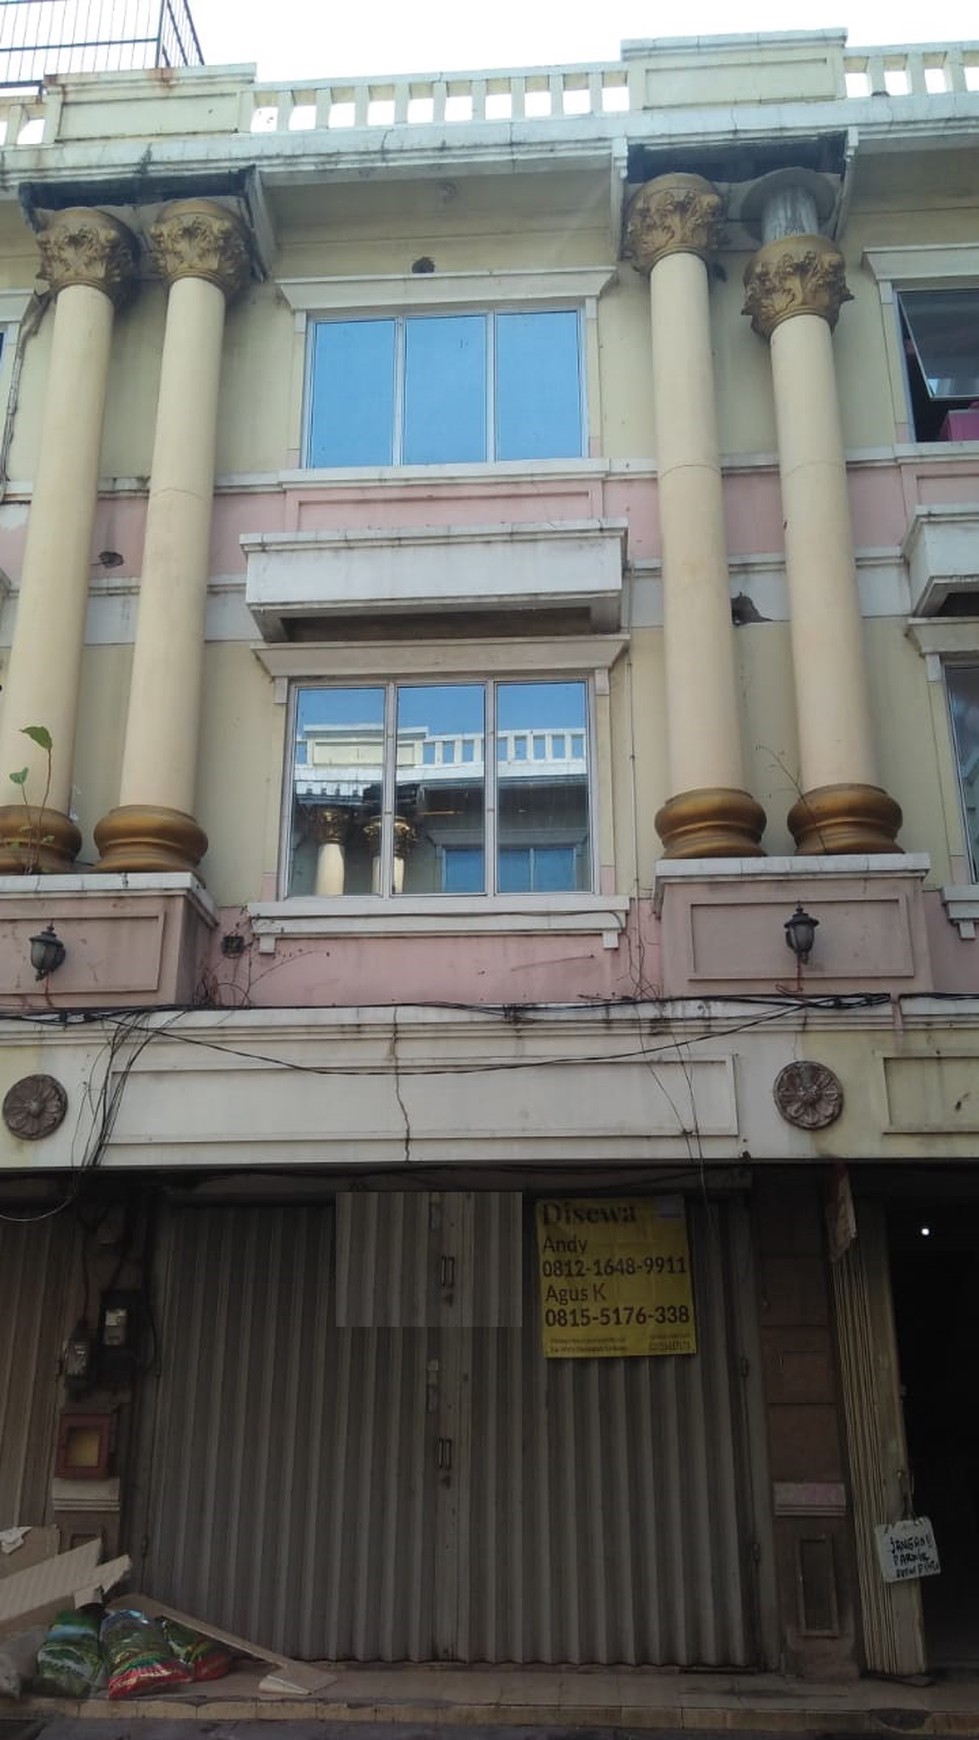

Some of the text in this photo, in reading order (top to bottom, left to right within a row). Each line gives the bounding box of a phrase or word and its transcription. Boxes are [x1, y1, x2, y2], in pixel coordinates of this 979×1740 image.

[543, 1201, 636, 1225] Disewa
[543, 1235, 588, 1255] Andy
[542, 1256, 687, 1278] 0812-1648-9911
[545, 1282, 607, 1306] Agus K
[545, 1305, 690, 1328] 0815-5176-338
